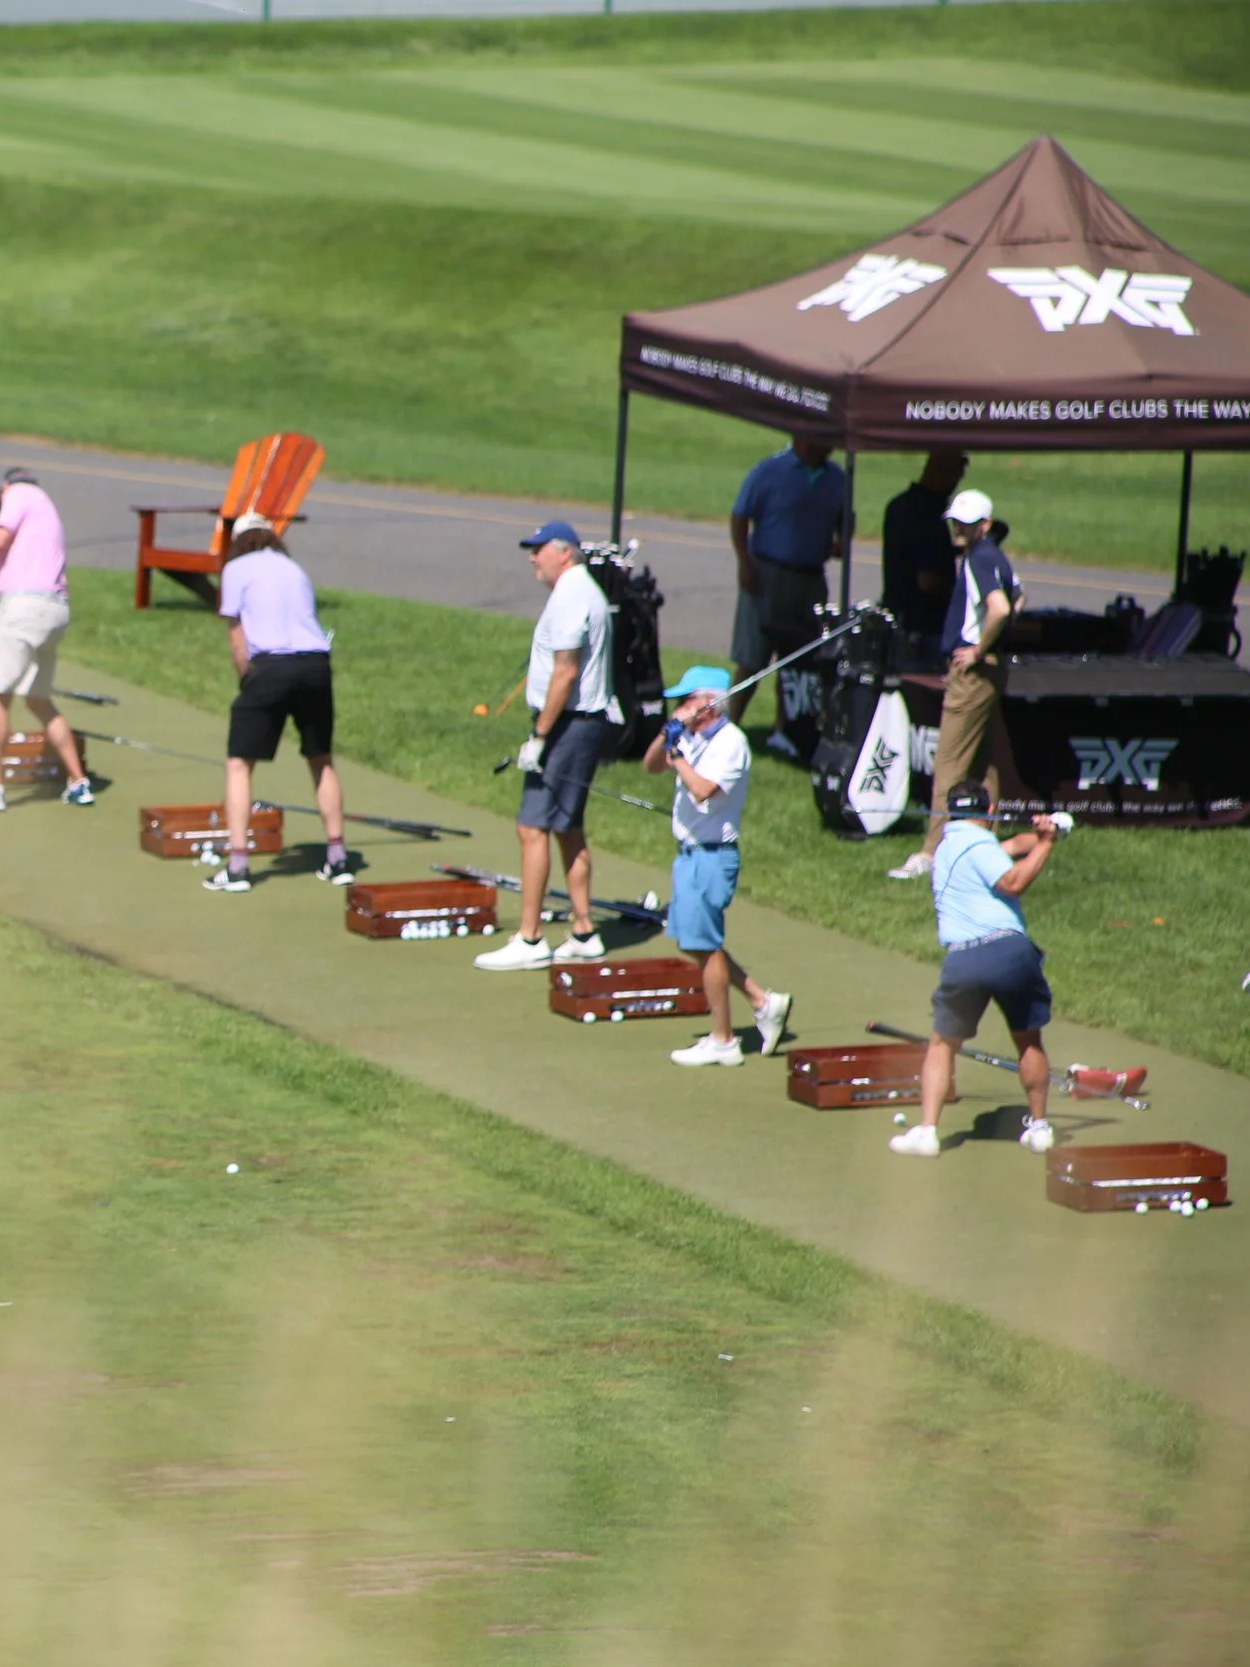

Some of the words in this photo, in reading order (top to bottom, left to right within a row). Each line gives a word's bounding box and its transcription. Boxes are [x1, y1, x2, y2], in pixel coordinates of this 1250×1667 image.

[987, 265, 1194, 336] PXG
[905, 400, 986, 420] NOBODY
[989, 400, 1052, 420] MAKES
[1055, 399, 1105, 420] GOLF
[1108, 398, 1168, 419] CLUBS
[1173, 399, 1209, 419] THE
[1213, 399, 1250, 419] WAY
[858, 736, 899, 794] PXG
[1068, 738, 1180, 791] PXG
